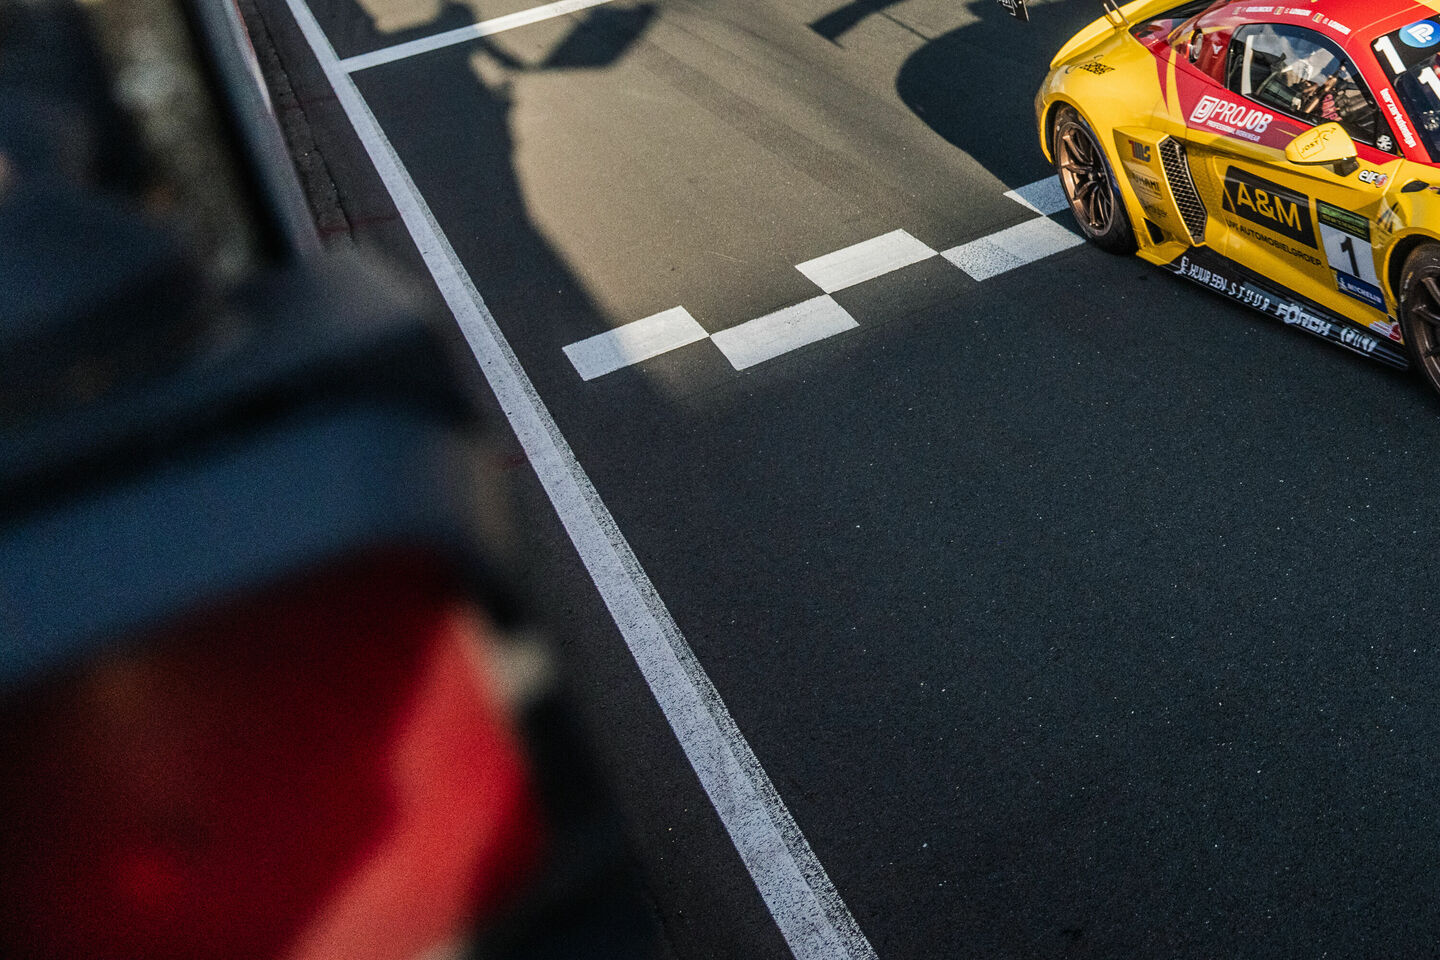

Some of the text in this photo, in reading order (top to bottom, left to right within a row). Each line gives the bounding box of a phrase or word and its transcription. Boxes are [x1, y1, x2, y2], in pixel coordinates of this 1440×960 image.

[1374, 36, 1407, 75] 1
[1210, 100, 1273, 133] PROJOB
[1237, 182, 1302, 232] A&M
[1340, 236, 1360, 278] 1
